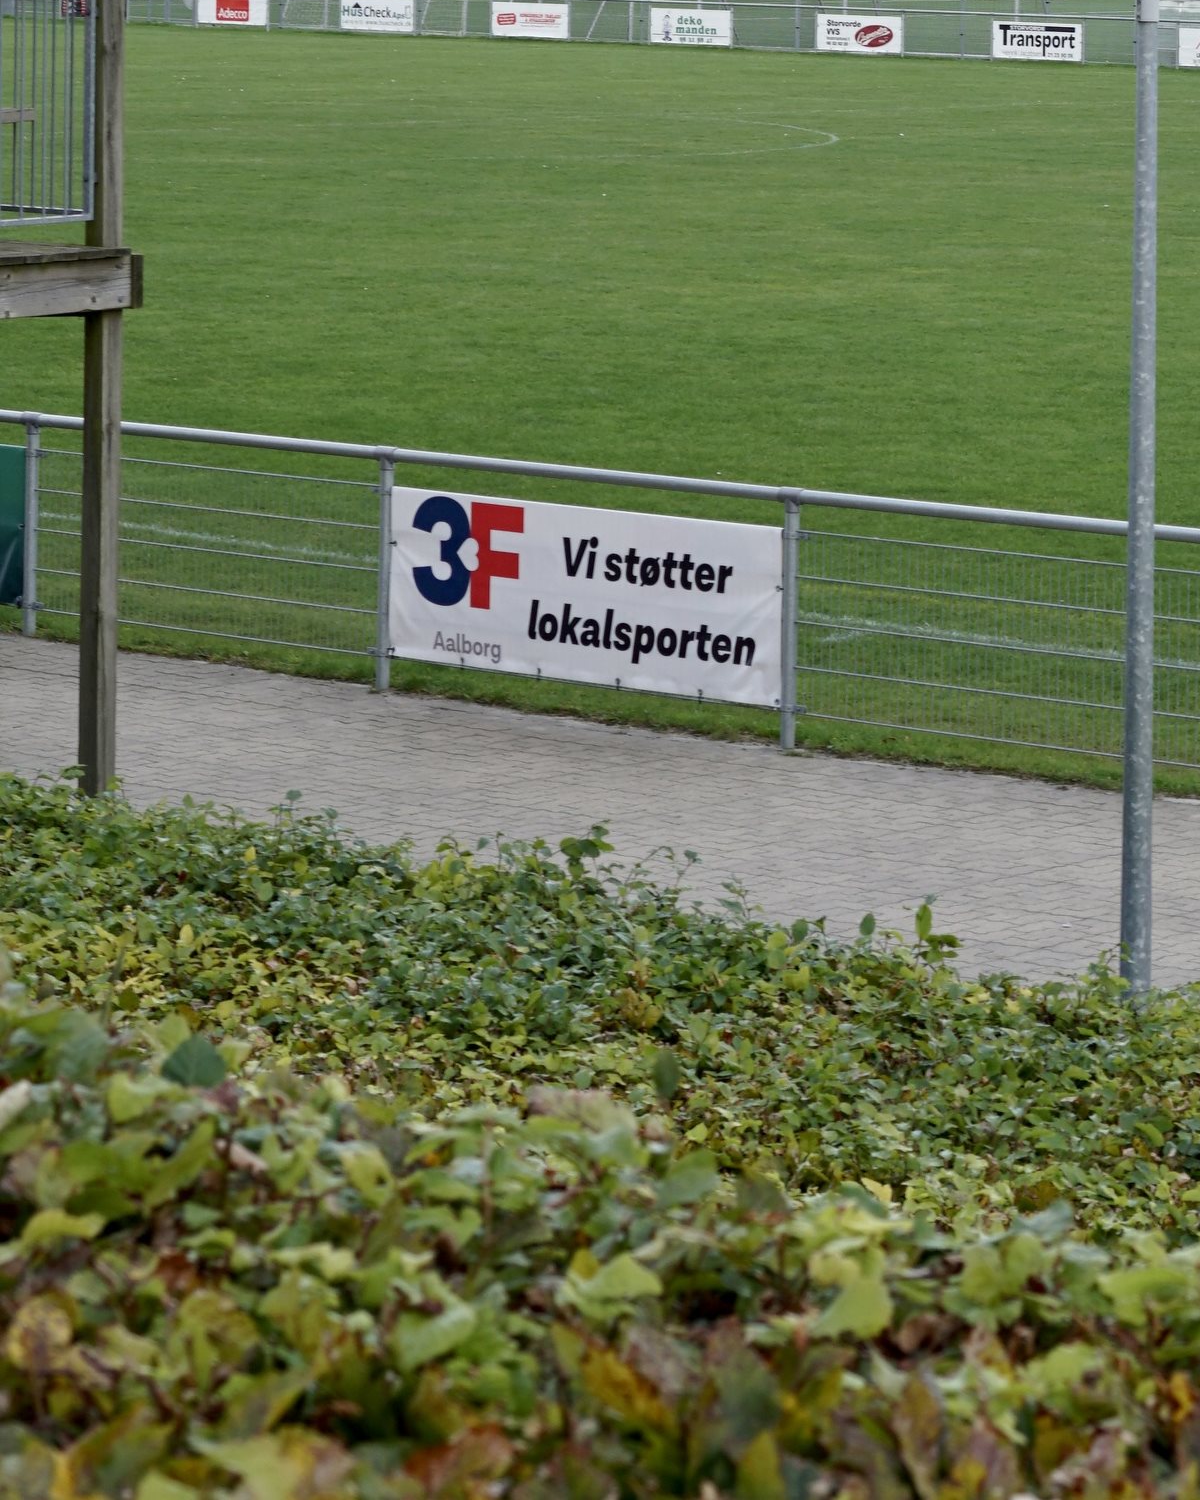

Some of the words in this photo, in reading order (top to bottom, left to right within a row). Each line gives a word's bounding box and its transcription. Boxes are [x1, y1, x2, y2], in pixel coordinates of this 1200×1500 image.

[217, 8, 247, 19] Adecco
[677, 15, 702, 26] deko
[826, 19, 861, 28] Storvorde
[675, 25, 717, 35] manden
[826, 28, 840, 36] VVS
[999, 24, 1075, 57] Transport
[412, 496, 524, 610] 3F
[562, 536, 598, 580] Vi
[604, 547, 733, 594] støtter
[528, 599, 756, 667] lokalsporten
[433, 631, 502, 663] Aalborg
